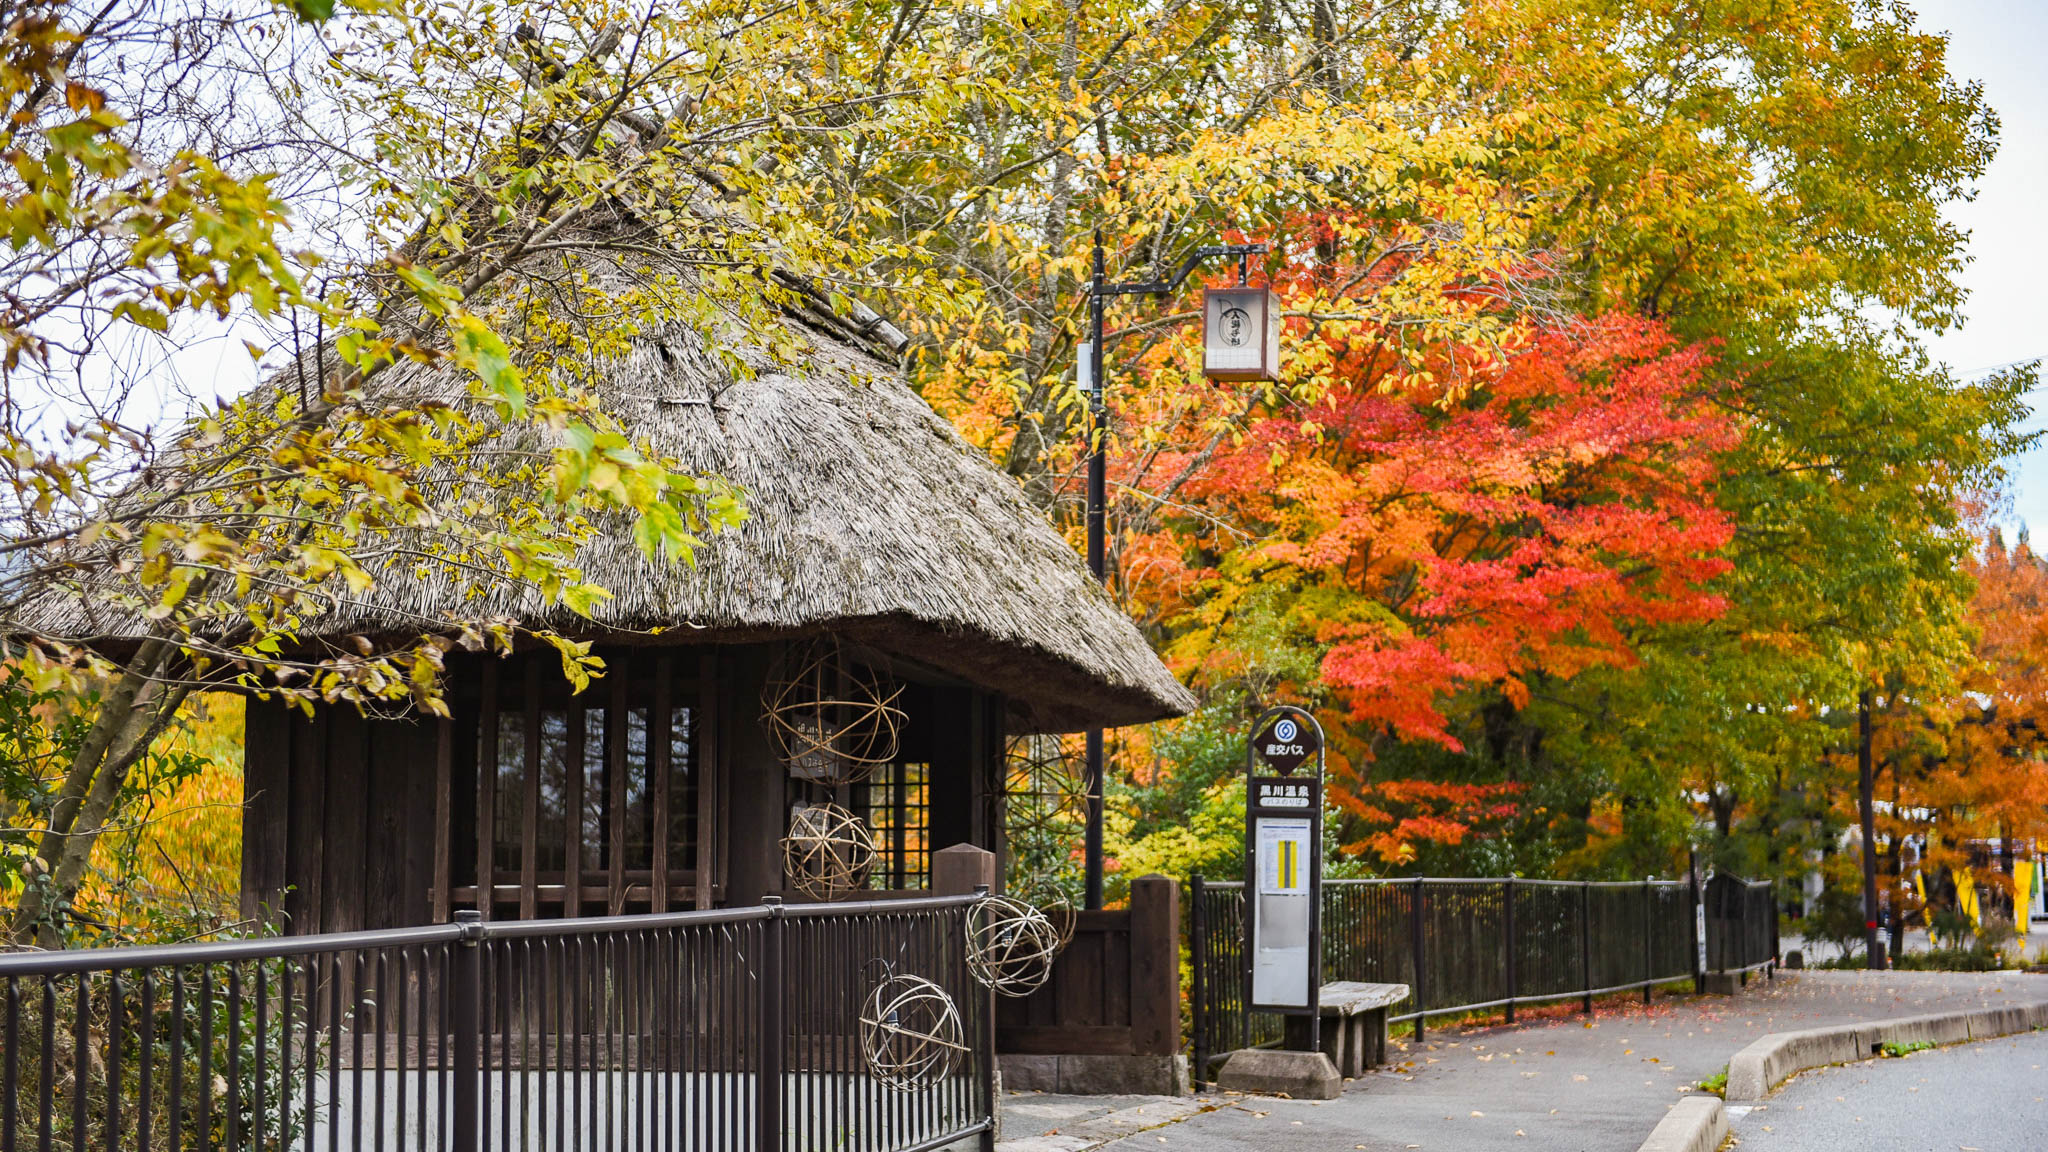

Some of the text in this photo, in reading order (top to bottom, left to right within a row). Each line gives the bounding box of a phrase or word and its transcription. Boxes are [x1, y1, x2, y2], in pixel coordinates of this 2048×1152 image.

[1266, 744, 1304, 756] 産交バス
[1260, 785, 1309, 797] 黒川温泉
